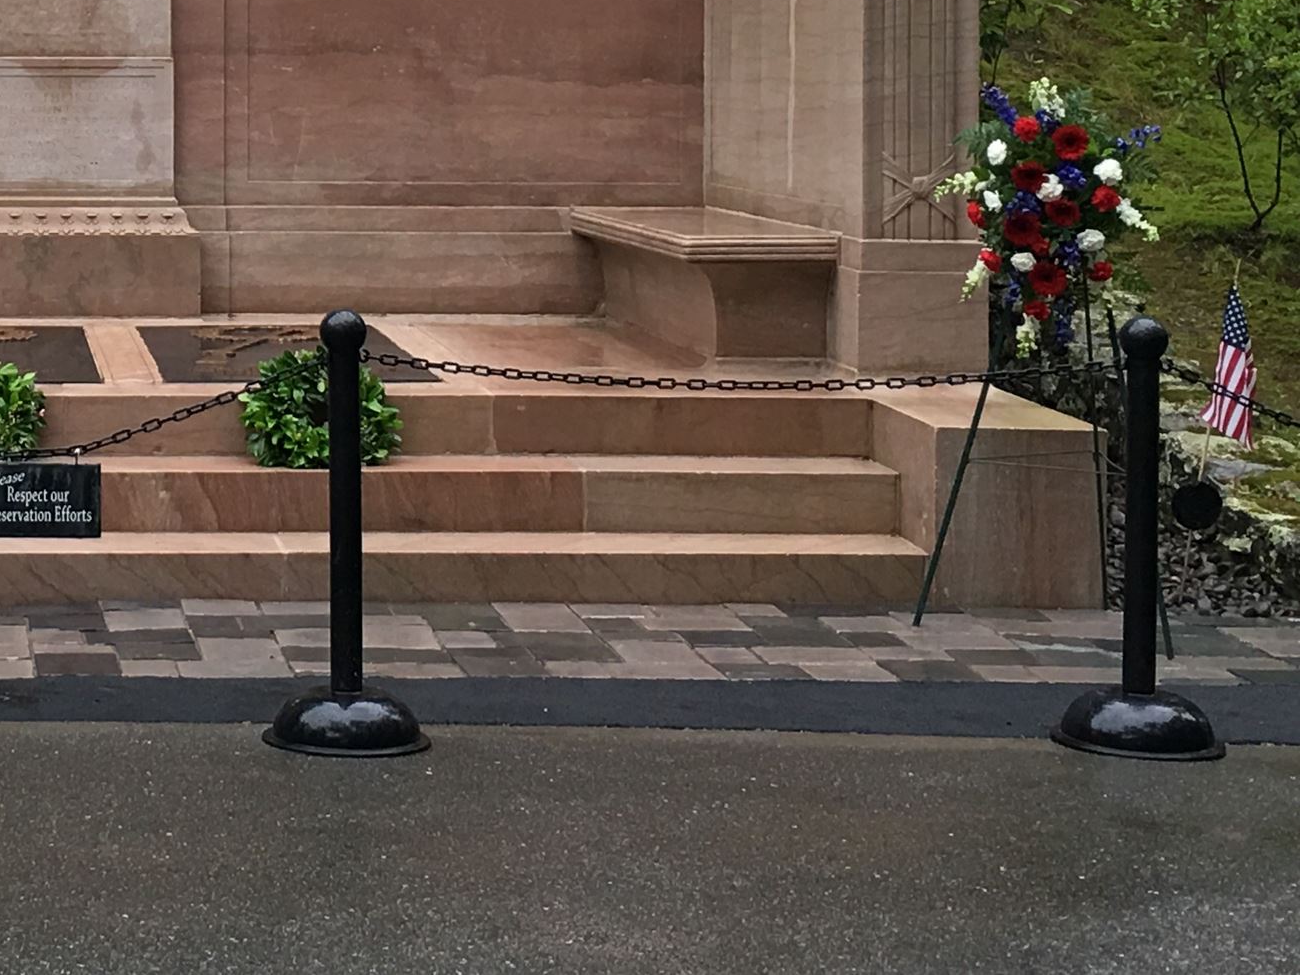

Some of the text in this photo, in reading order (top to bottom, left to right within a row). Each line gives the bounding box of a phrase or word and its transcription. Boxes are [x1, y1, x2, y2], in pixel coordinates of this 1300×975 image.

[7, 485, 70, 507] Respect our
[54, 505, 93, 522] Efforts
